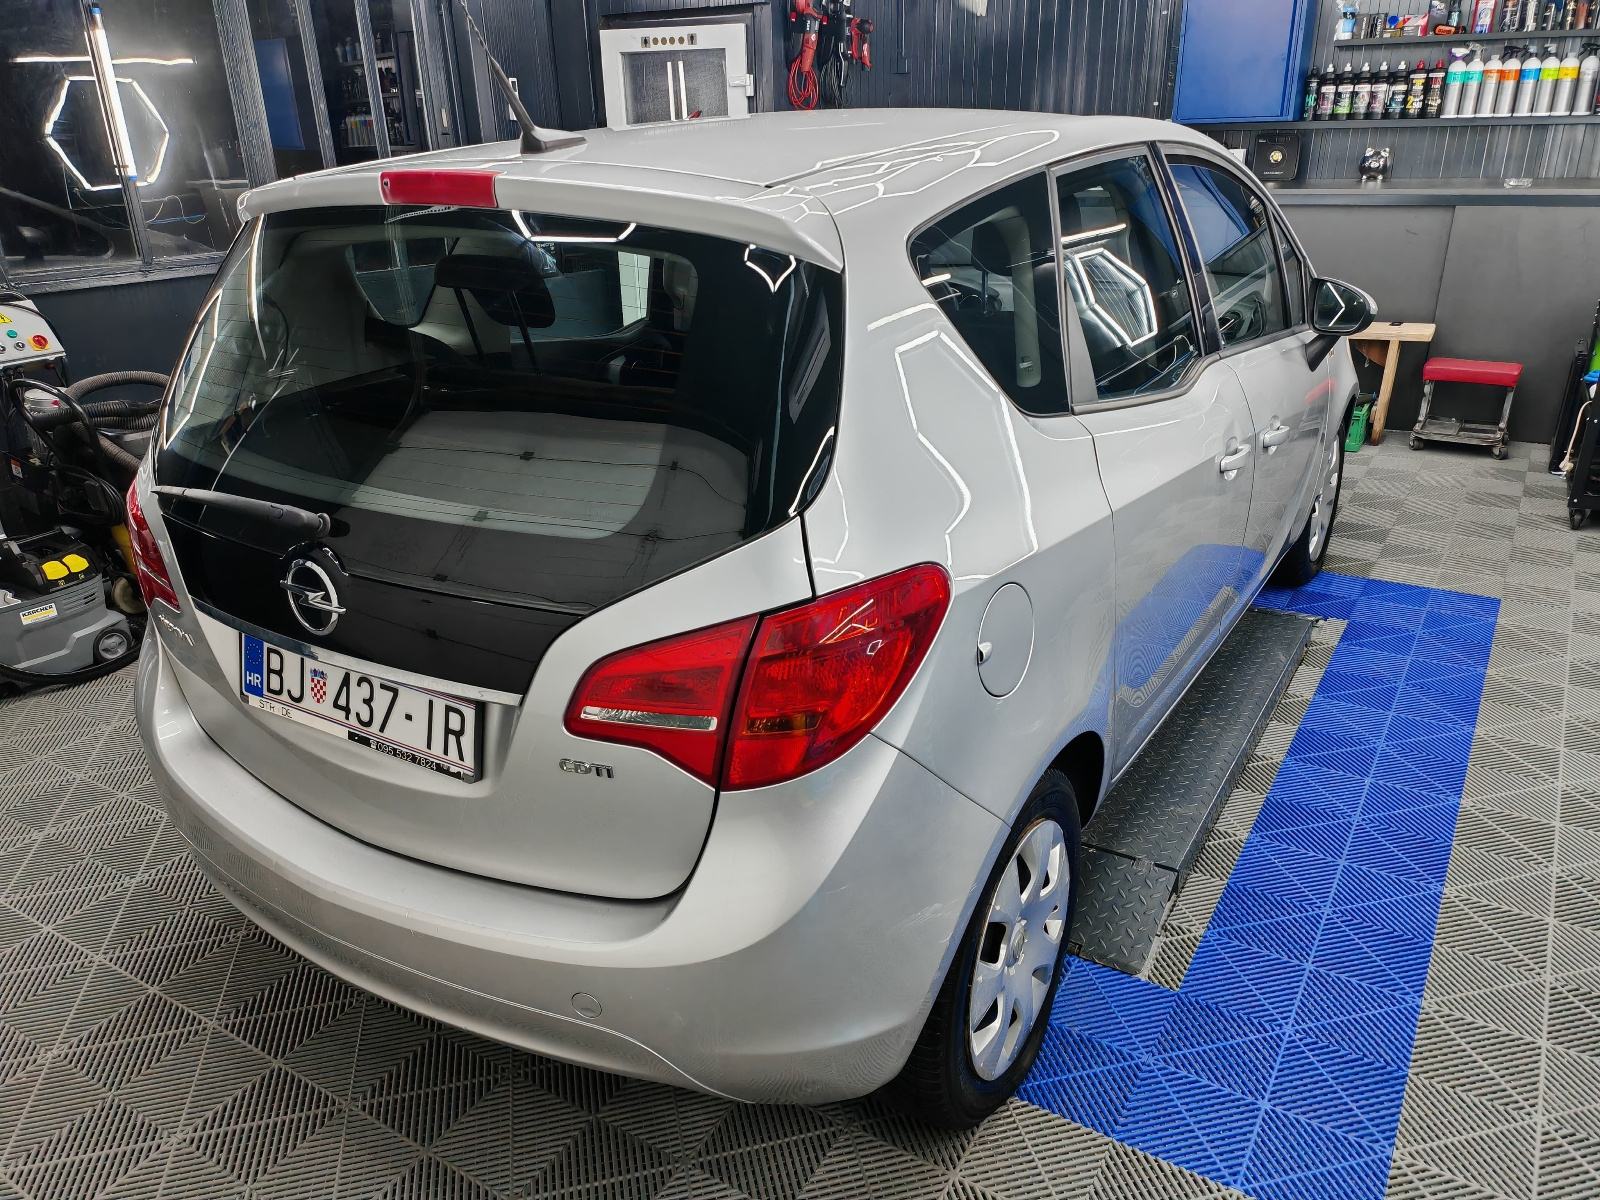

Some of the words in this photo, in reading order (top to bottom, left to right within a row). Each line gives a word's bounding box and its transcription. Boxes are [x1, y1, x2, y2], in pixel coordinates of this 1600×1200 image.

[246, 670, 262, 688] HR
[266, 646, 305, 704] BJ
[376, 742, 394, 756] 095
[396, 752, 413, 763] 532
[415, 755, 438, 771] 7824
[559, 758, 614, 779] CDTI
